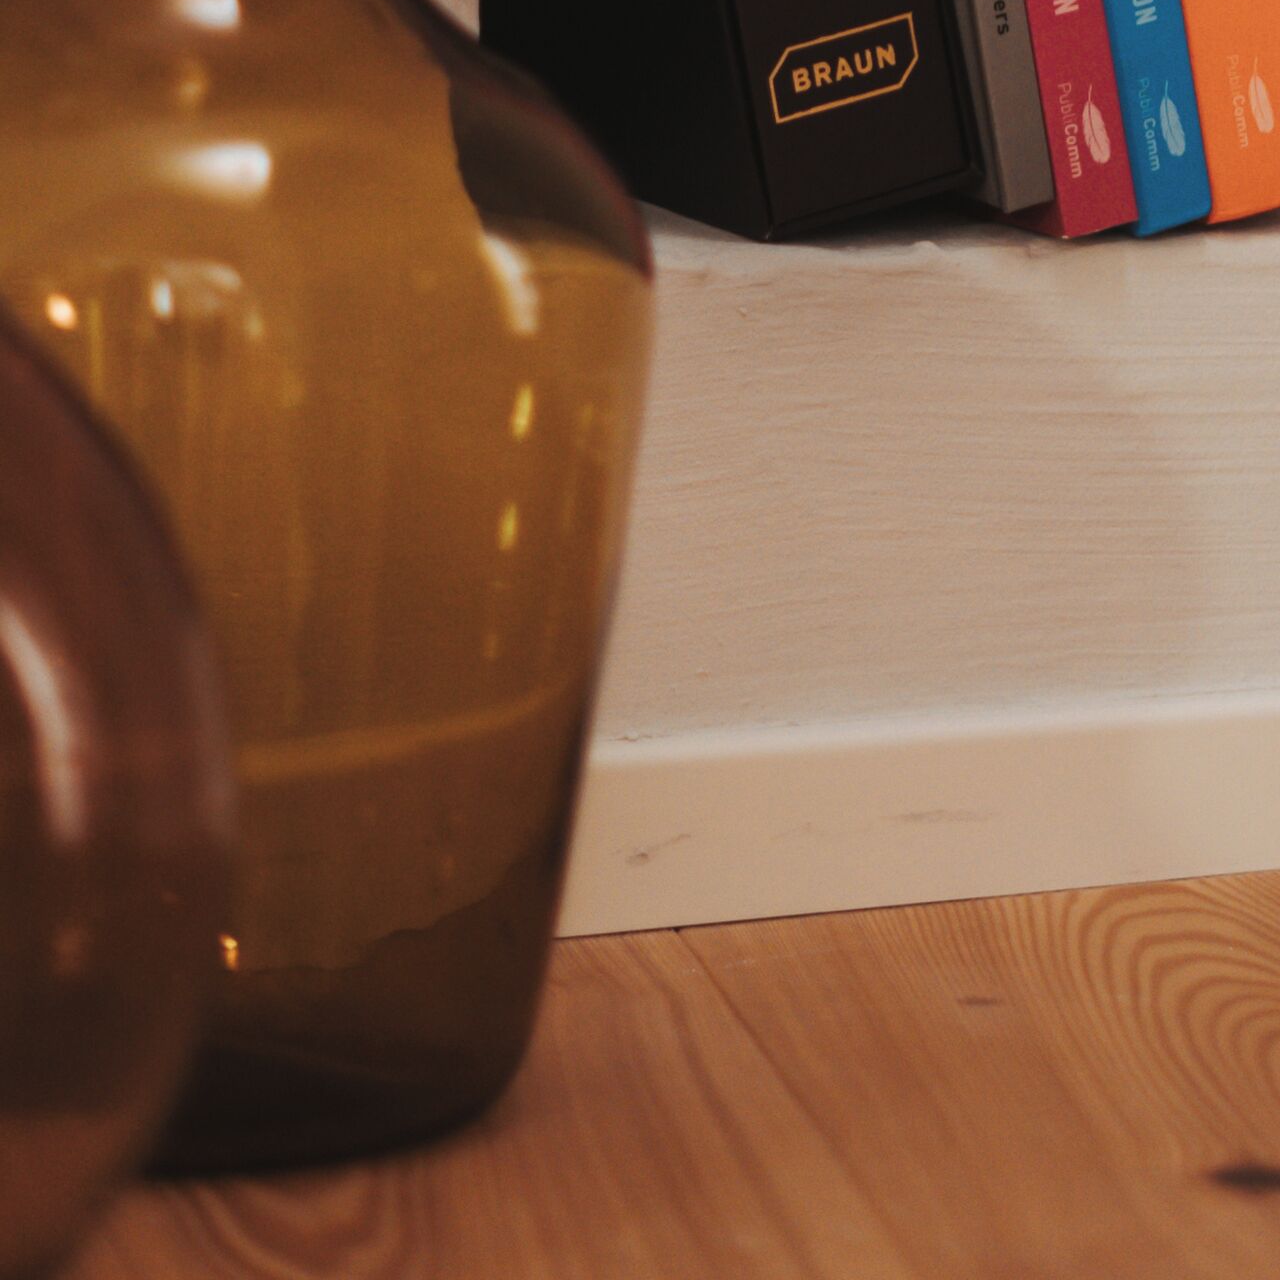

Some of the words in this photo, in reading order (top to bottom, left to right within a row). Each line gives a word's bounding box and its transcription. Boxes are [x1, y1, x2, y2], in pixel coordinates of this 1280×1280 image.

[792, 45, 898, 93] BRAUN
[1227, 53, 1249, 149] PubliComm
[1057, 82, 1083, 179] PubliComm
[1137, 76, 1161, 171] PubliComm
